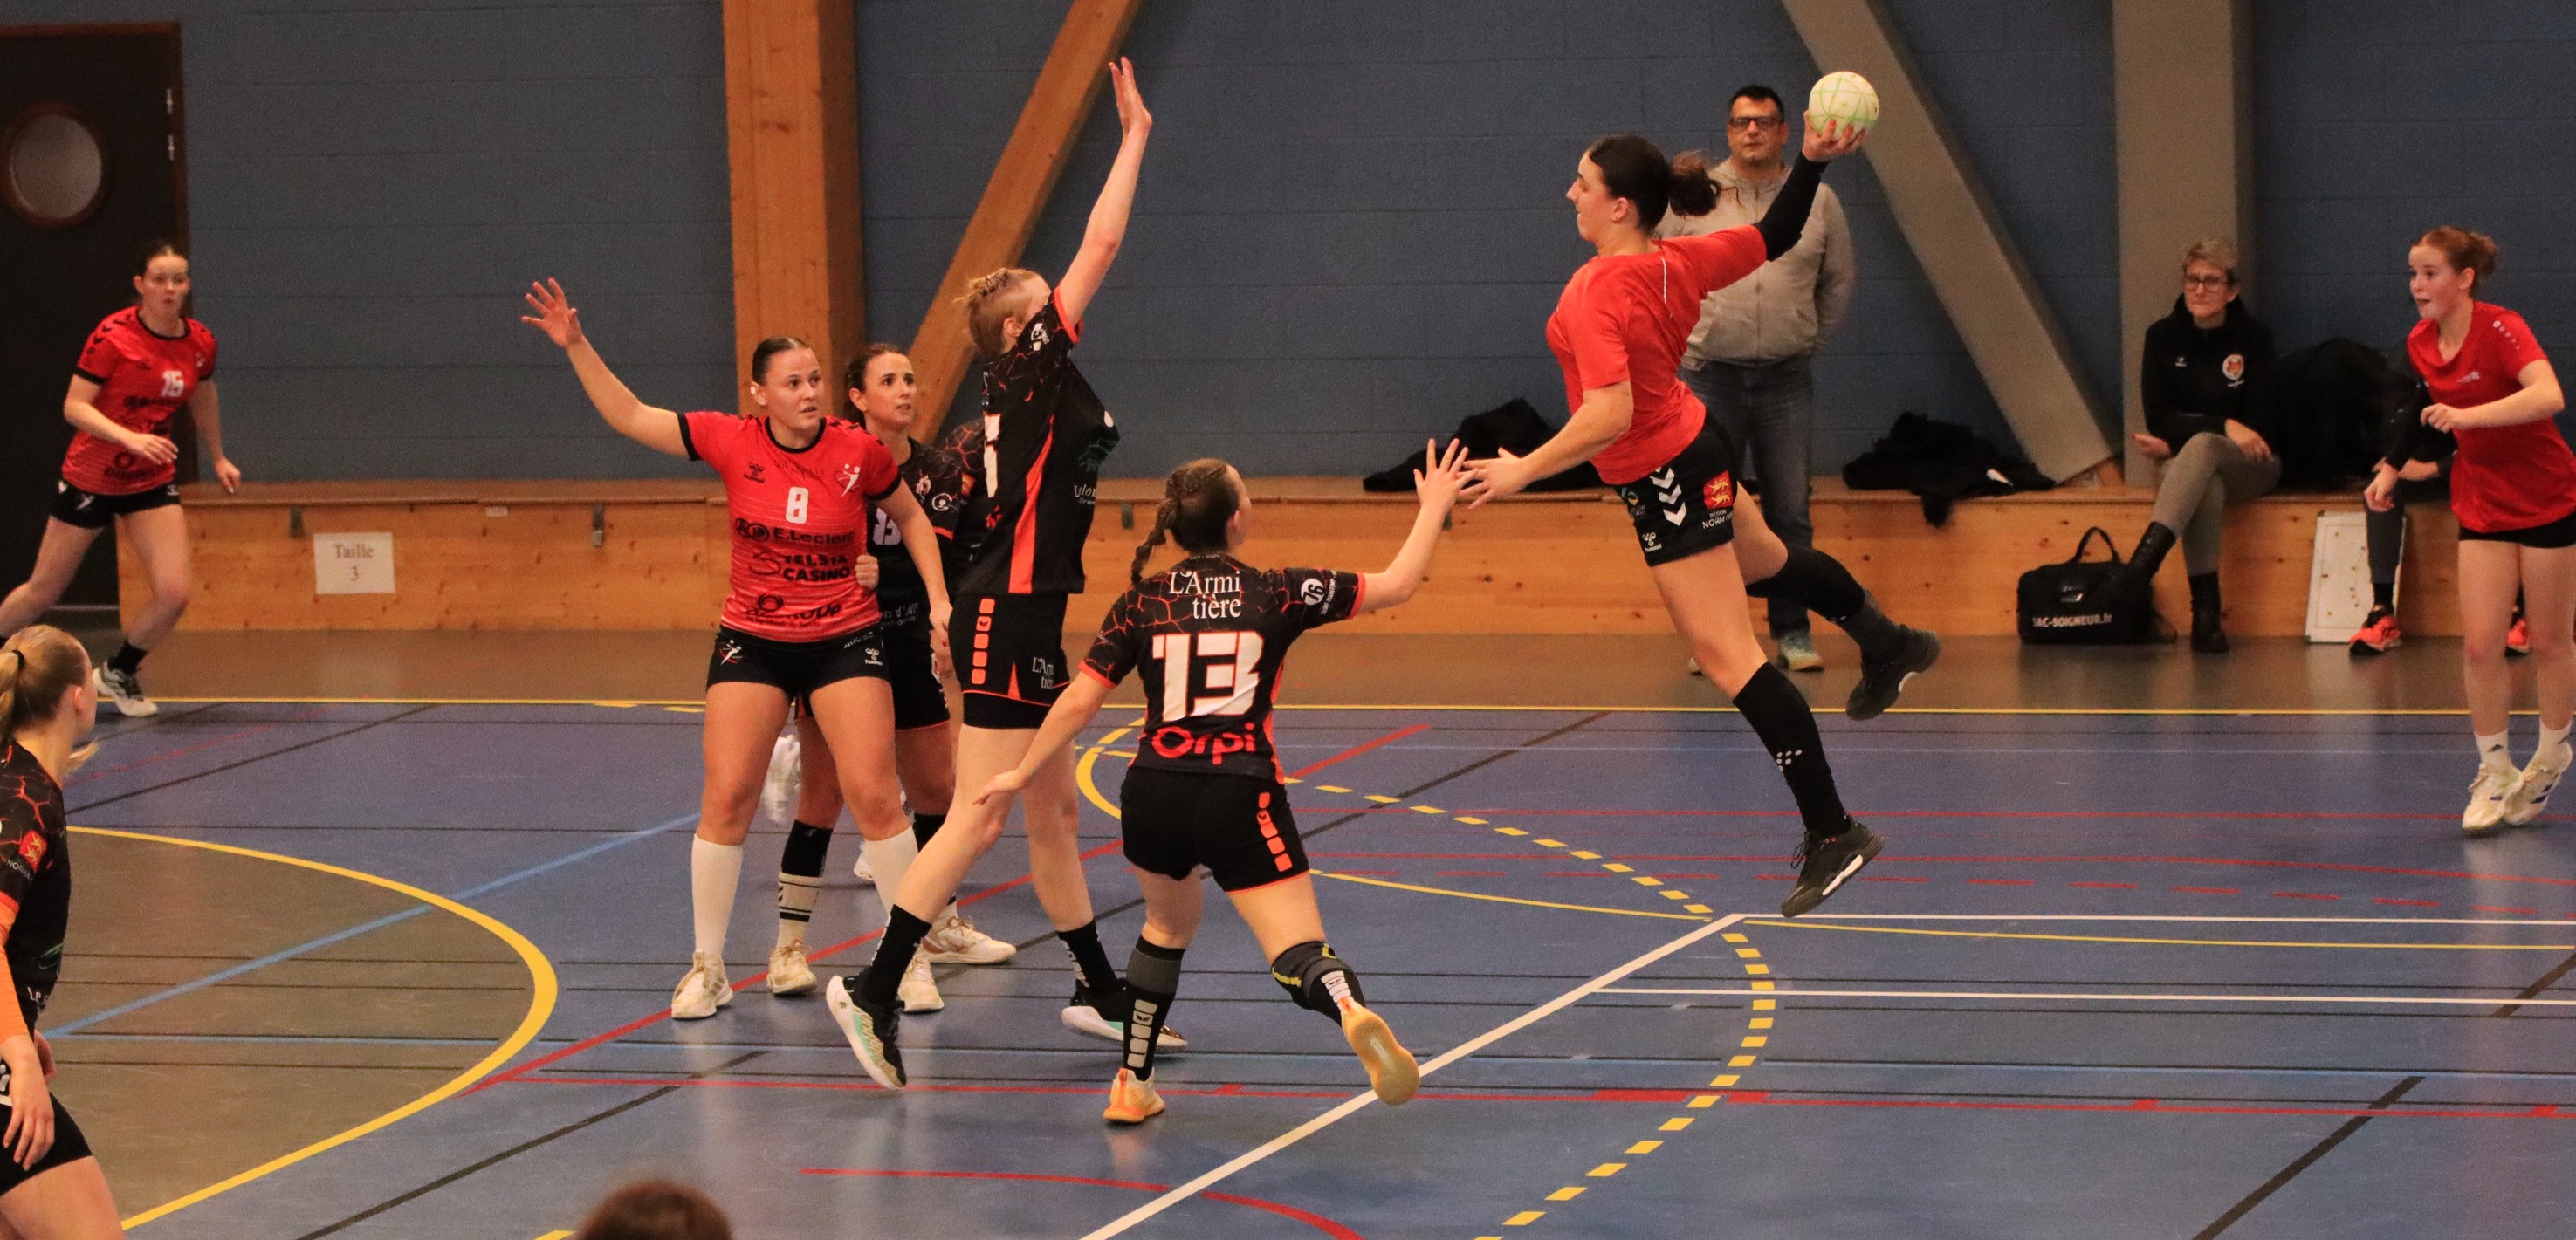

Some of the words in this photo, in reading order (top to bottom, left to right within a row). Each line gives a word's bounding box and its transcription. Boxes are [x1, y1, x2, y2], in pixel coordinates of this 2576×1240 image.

[786, 486, 808, 524] 8
[333, 545, 374, 558] Taille
[350, 565, 359, 581] 3
[783, 567, 851, 582] CASINO
[1169, 571, 1240, 594] L'Armi
[1302, 583, 1325, 602] 76
[1192, 594, 1241, 620] tière
[1152, 631, 1264, 723] 13
[1151, 722, 1256, 765] Orpi
